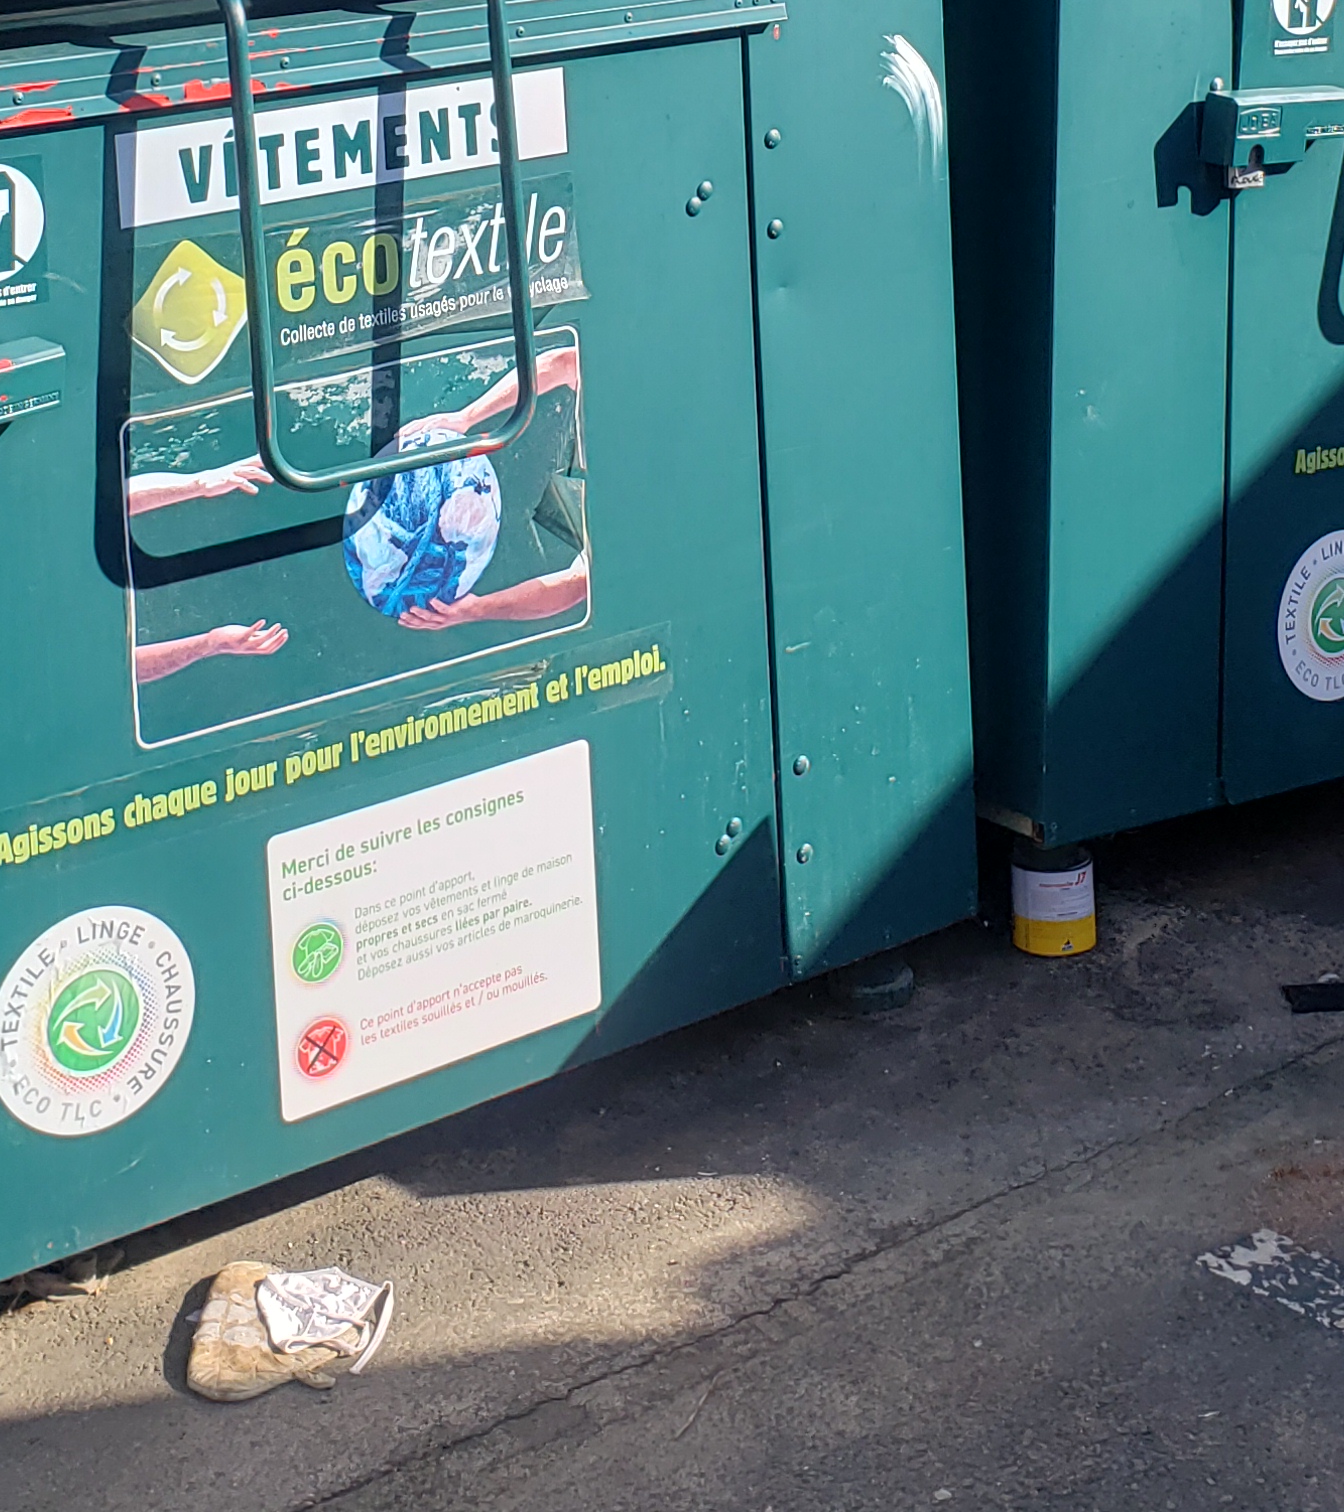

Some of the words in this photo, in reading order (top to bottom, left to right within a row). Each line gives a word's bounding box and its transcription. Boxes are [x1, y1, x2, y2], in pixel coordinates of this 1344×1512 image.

[276, 193, 566, 313] écotextle
[280, 320, 335, 346] Collecte
[339, 315, 355, 334] de
[359, 306, 407, 330] textiles
[410, 294, 456, 320] usagés
[459, 290, 487, 312] pour
[489, 283, 504, 303] le
[1285, 566, 1311, 645] TEXTILE
[1295, 660, 1319, 687] ECO
[124, 780, 217, 829] chaque
[225, 761, 277, 803] jour
[285, 741, 343, 784] pour
[351, 682, 540, 761] l'environnement
[546, 673, 569, 703] et
[575, 644, 666, 695] l'emploi.
[282, 849, 330, 879] Merci
[335, 843, 355, 862] de
[360, 825, 412, 854] suivre
[418, 816, 441, 836] les
[446, 789, 525, 826] consignes
[283, 859, 378, 901] ci-dessous:
[354, 903, 382, 919] Dans
[384, 898, 396, 909] ce
[399, 886, 426, 906] point
[355, 912, 399, 934] déposez
[402, 905, 421, 918] vos
[424, 885, 478, 911] vêtements
[481, 880, 491, 892] et
[494, 871, 519, 887] linge
[522, 866, 534, 878] de
[537, 854, 572, 873] maison
[76, 920, 146, 946] LINGE
[356, 928, 398, 952] propres
[402, 922, 412, 934] et
[416, 915, 438, 930] secs
[441, 909, 454, 921] en
[457, 902, 474, 916] sac
[477, 889, 507, 909] fermé
[357, 953, 367, 965] et
[370, 947, 389, 961] vos
[392, 925, 452, 953] chaussures
[483, 908, 500, 925] par
[503, 898, 533, 917] paire.
[357, 957, 403, 981] Déposez
[405, 944, 434, 964] aussi
[436, 939, 455, 953] vos
[457, 925, 496, 946] articles
[498, 919, 511, 932] de
[0, 947, 55, 1052] TEXTILE
[127, 950, 183, 1096] CHAUSSURE
[360, 1017, 374, 1030] Ce
[377, 1006, 404, 1027] point
[407, 990, 451, 1014] d'apport
[453, 972, 502, 998] n'accepte
[504, 964, 523, 982] pas
[360, 1034, 377, 1046] les
[380, 1017, 419, 1039] textiles
[422, 1000, 462, 1023] souillés
[465, 996, 475, 1009] et
[487, 989, 500, 1001] ou
[13, 1074, 51, 1115] ECO
[60, 1099, 102, 1124] TLC
